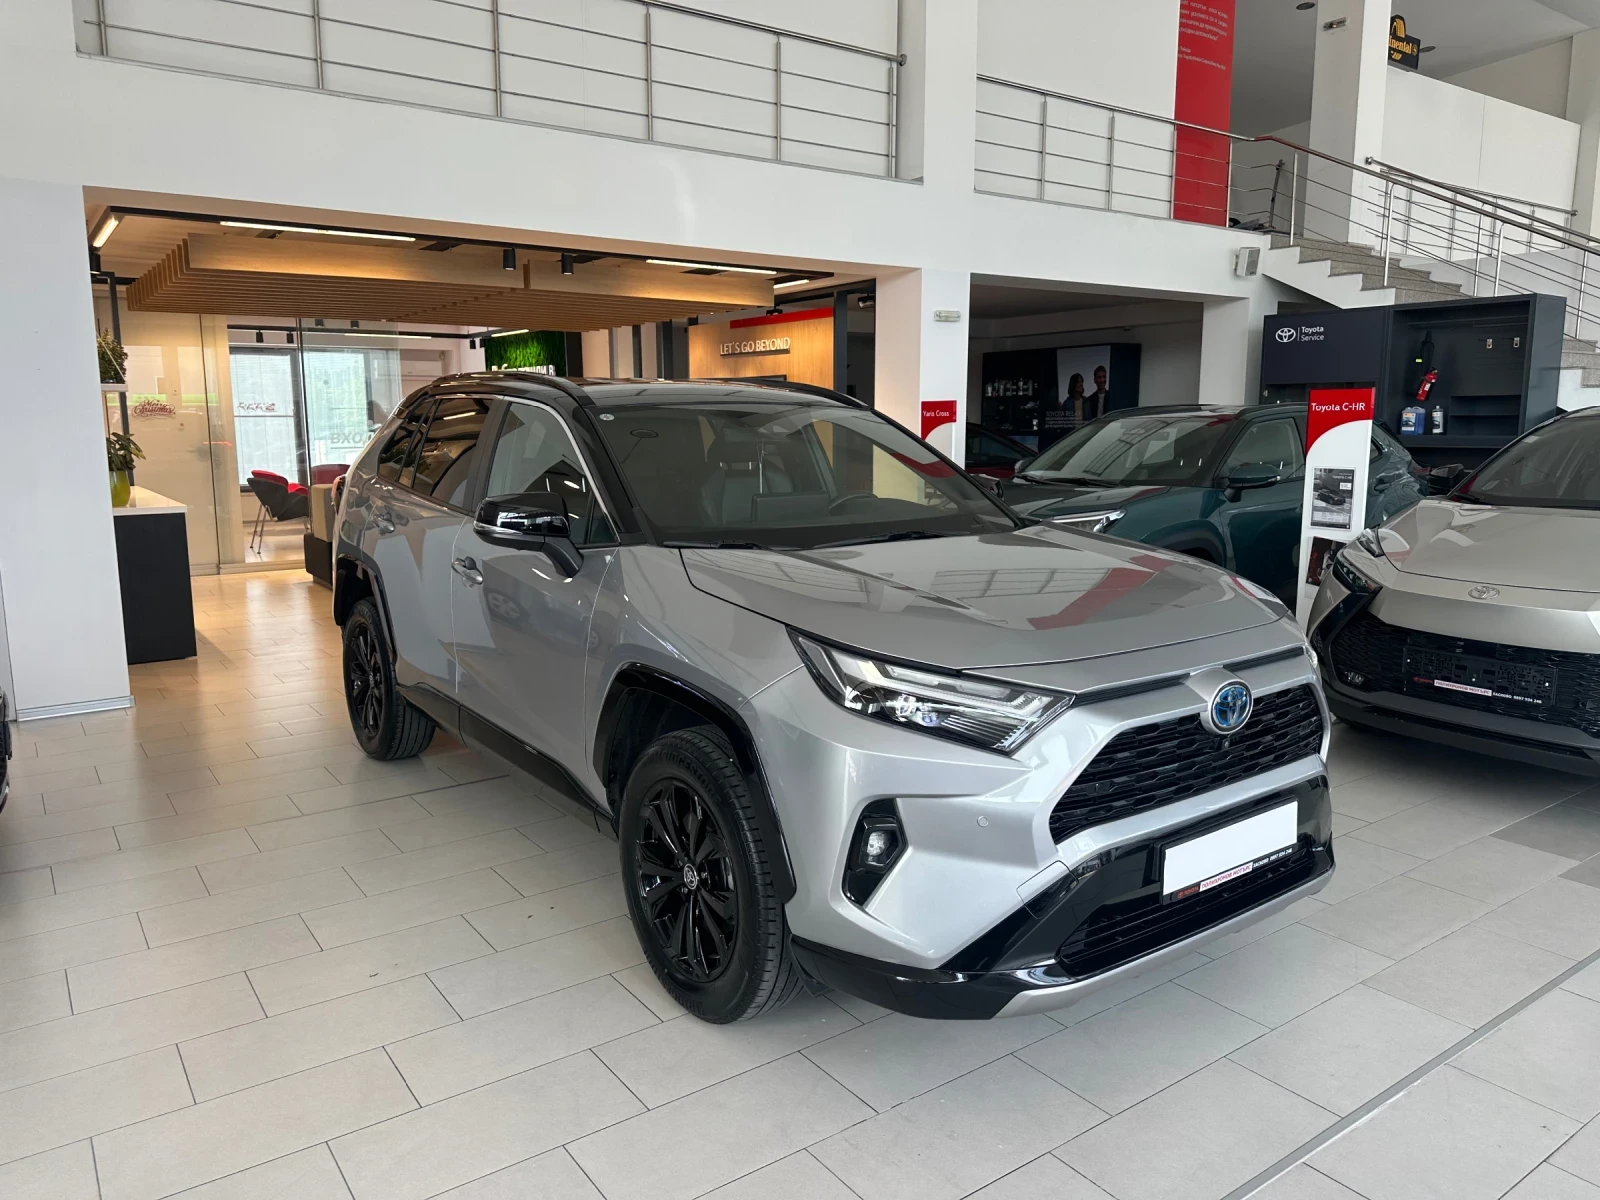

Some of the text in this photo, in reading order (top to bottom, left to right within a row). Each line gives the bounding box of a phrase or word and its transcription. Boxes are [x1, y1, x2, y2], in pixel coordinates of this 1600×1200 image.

[1389, 36, 1412, 54] inental
[1301, 326, 1324, 334] Toyota
[741, 341, 754, 352] GO
[755, 337, 791, 352] BEYOND
[935, 409, 950, 417] Cross
[1311, 402, 1366, 413] Toyota C-HR
